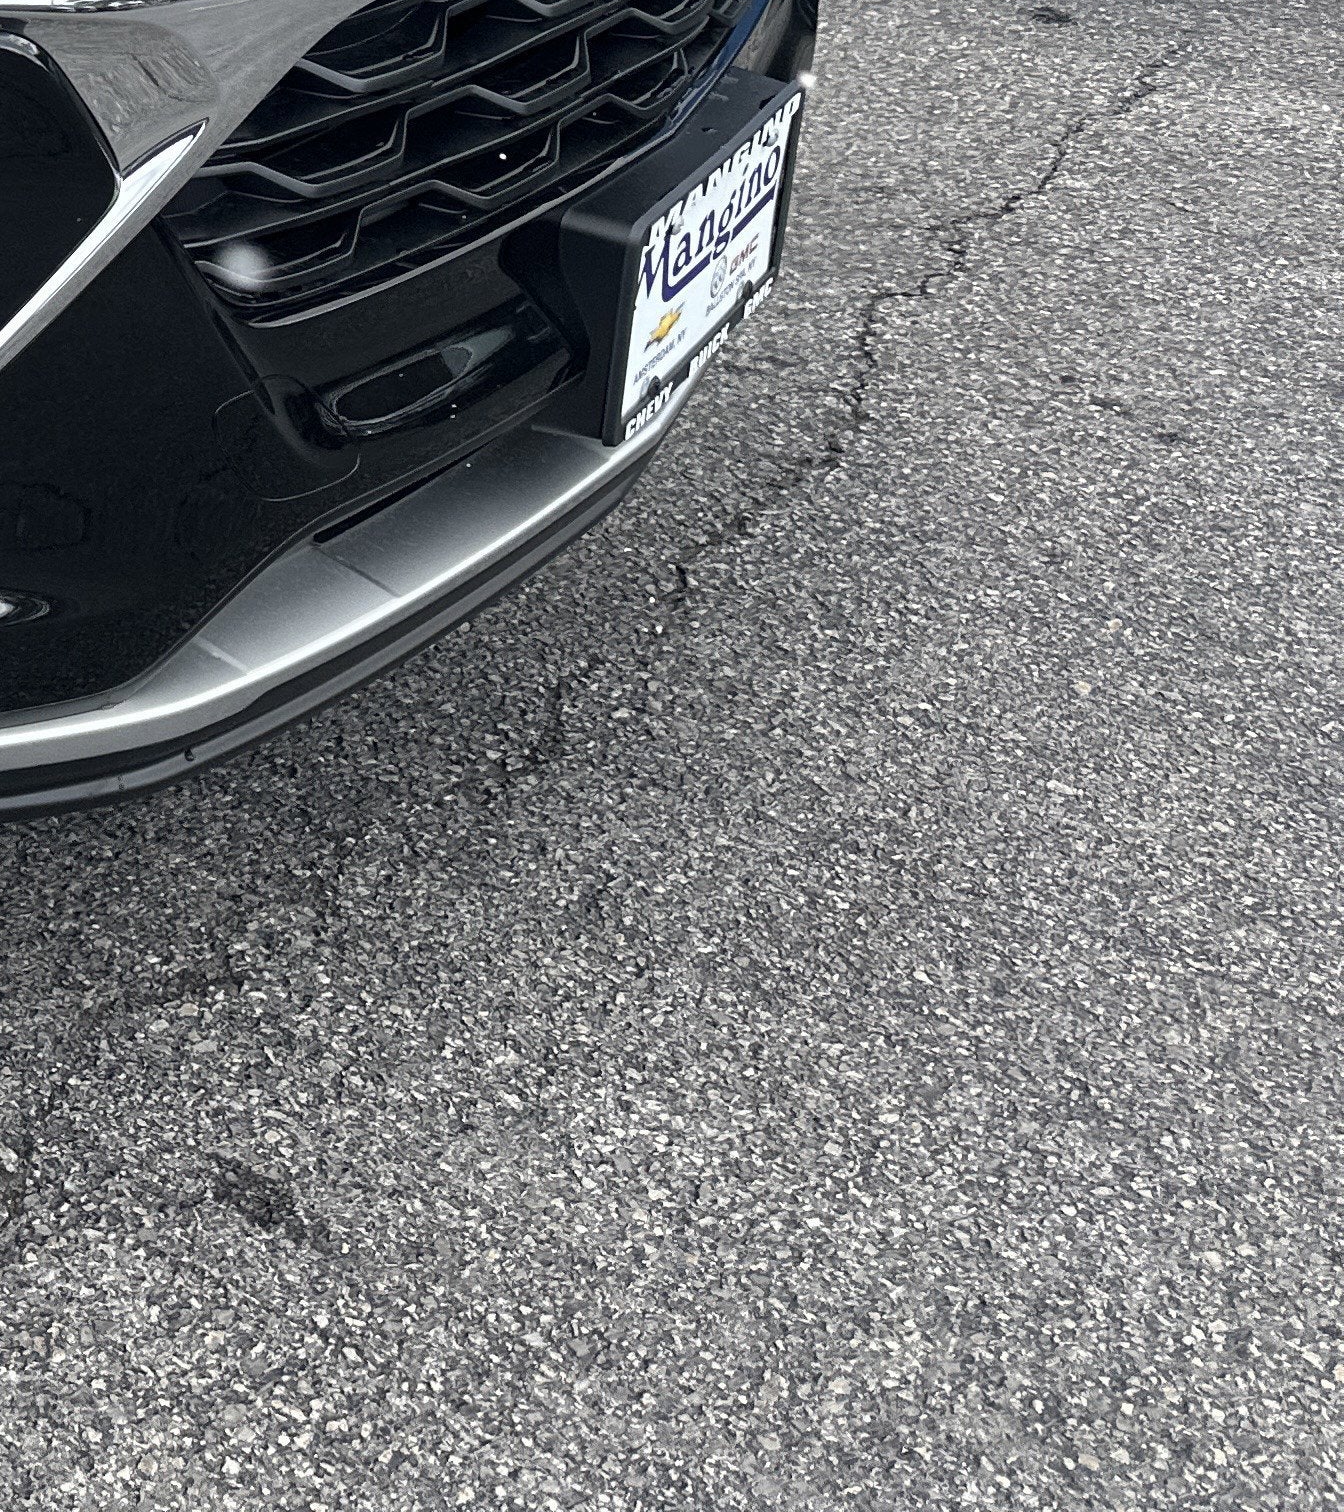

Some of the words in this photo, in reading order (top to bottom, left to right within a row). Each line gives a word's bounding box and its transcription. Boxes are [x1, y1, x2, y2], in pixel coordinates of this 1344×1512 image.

[639, 145, 782, 302] Mangino
[730, 233, 760, 275] GMC
[625, 382, 674, 441] CHEVY
[688, 322, 730, 379] BUICK
[743, 277, 774, 320] GMC
